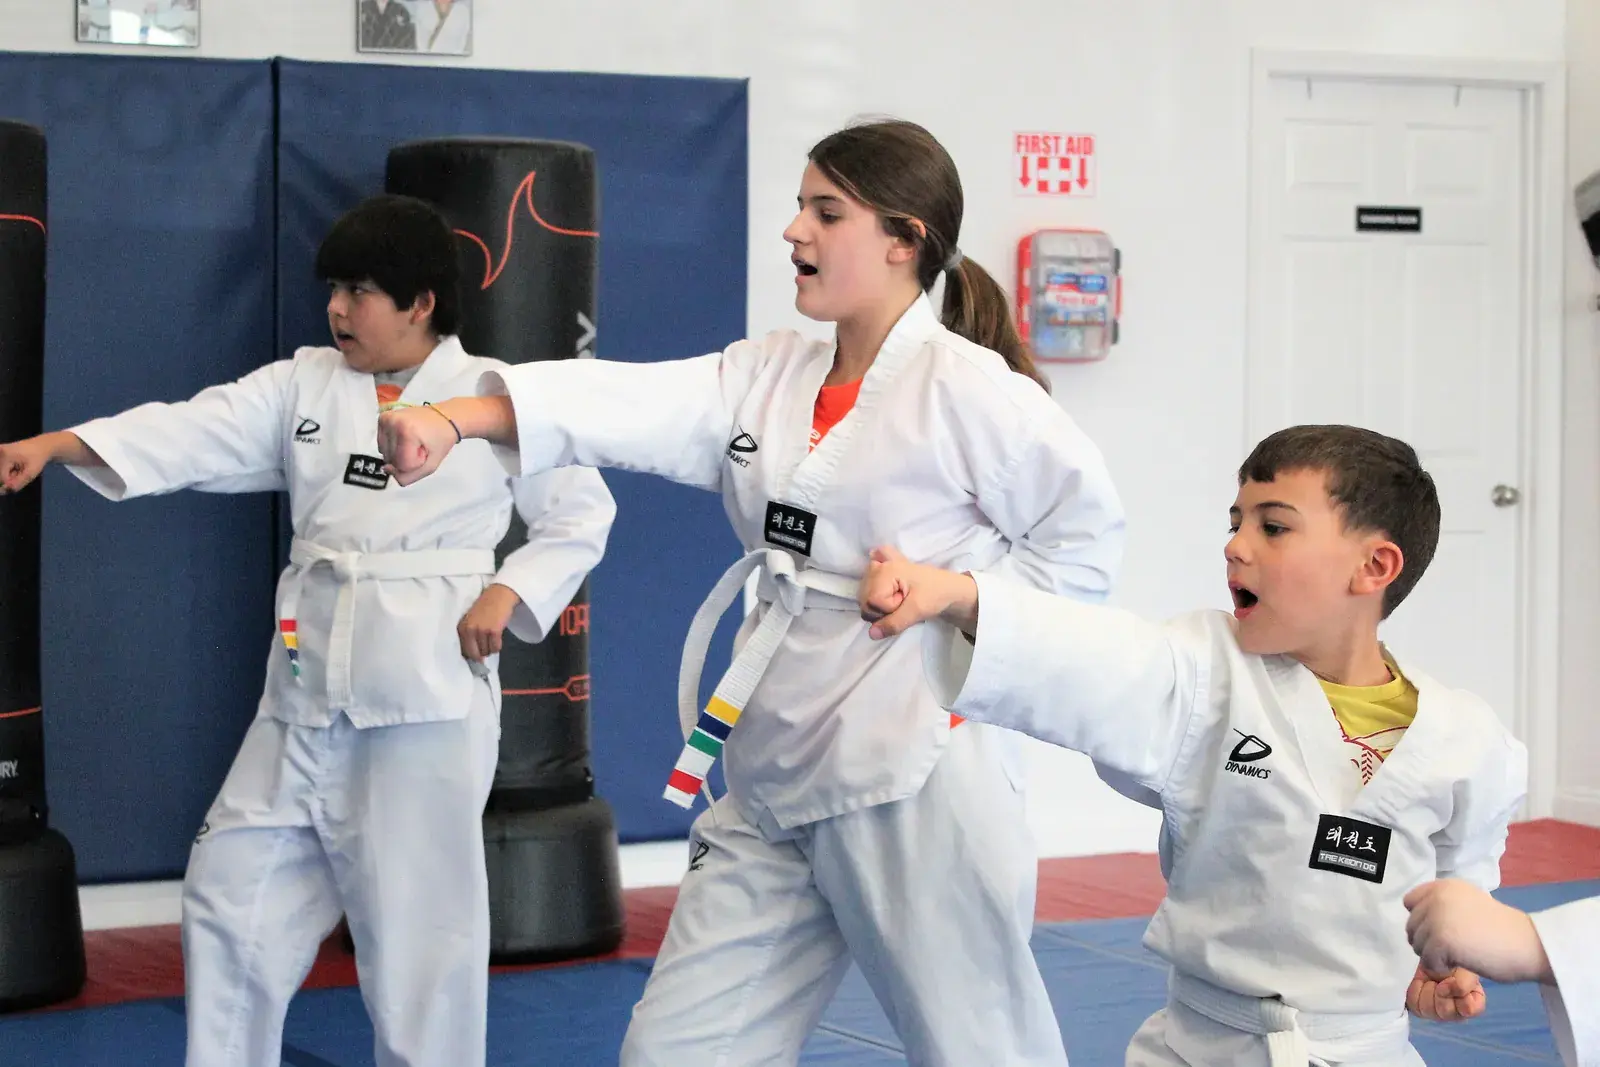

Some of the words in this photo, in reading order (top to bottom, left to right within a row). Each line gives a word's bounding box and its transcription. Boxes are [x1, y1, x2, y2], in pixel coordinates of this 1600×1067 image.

[1016, 134, 1061, 155] FIRST
[1066, 136, 1092, 155] AID
[1225, 761, 1272, 779] DYNAMICS
[1325, 825, 1377, 853] 태권도
[1362, 862, 1377, 872] DO
